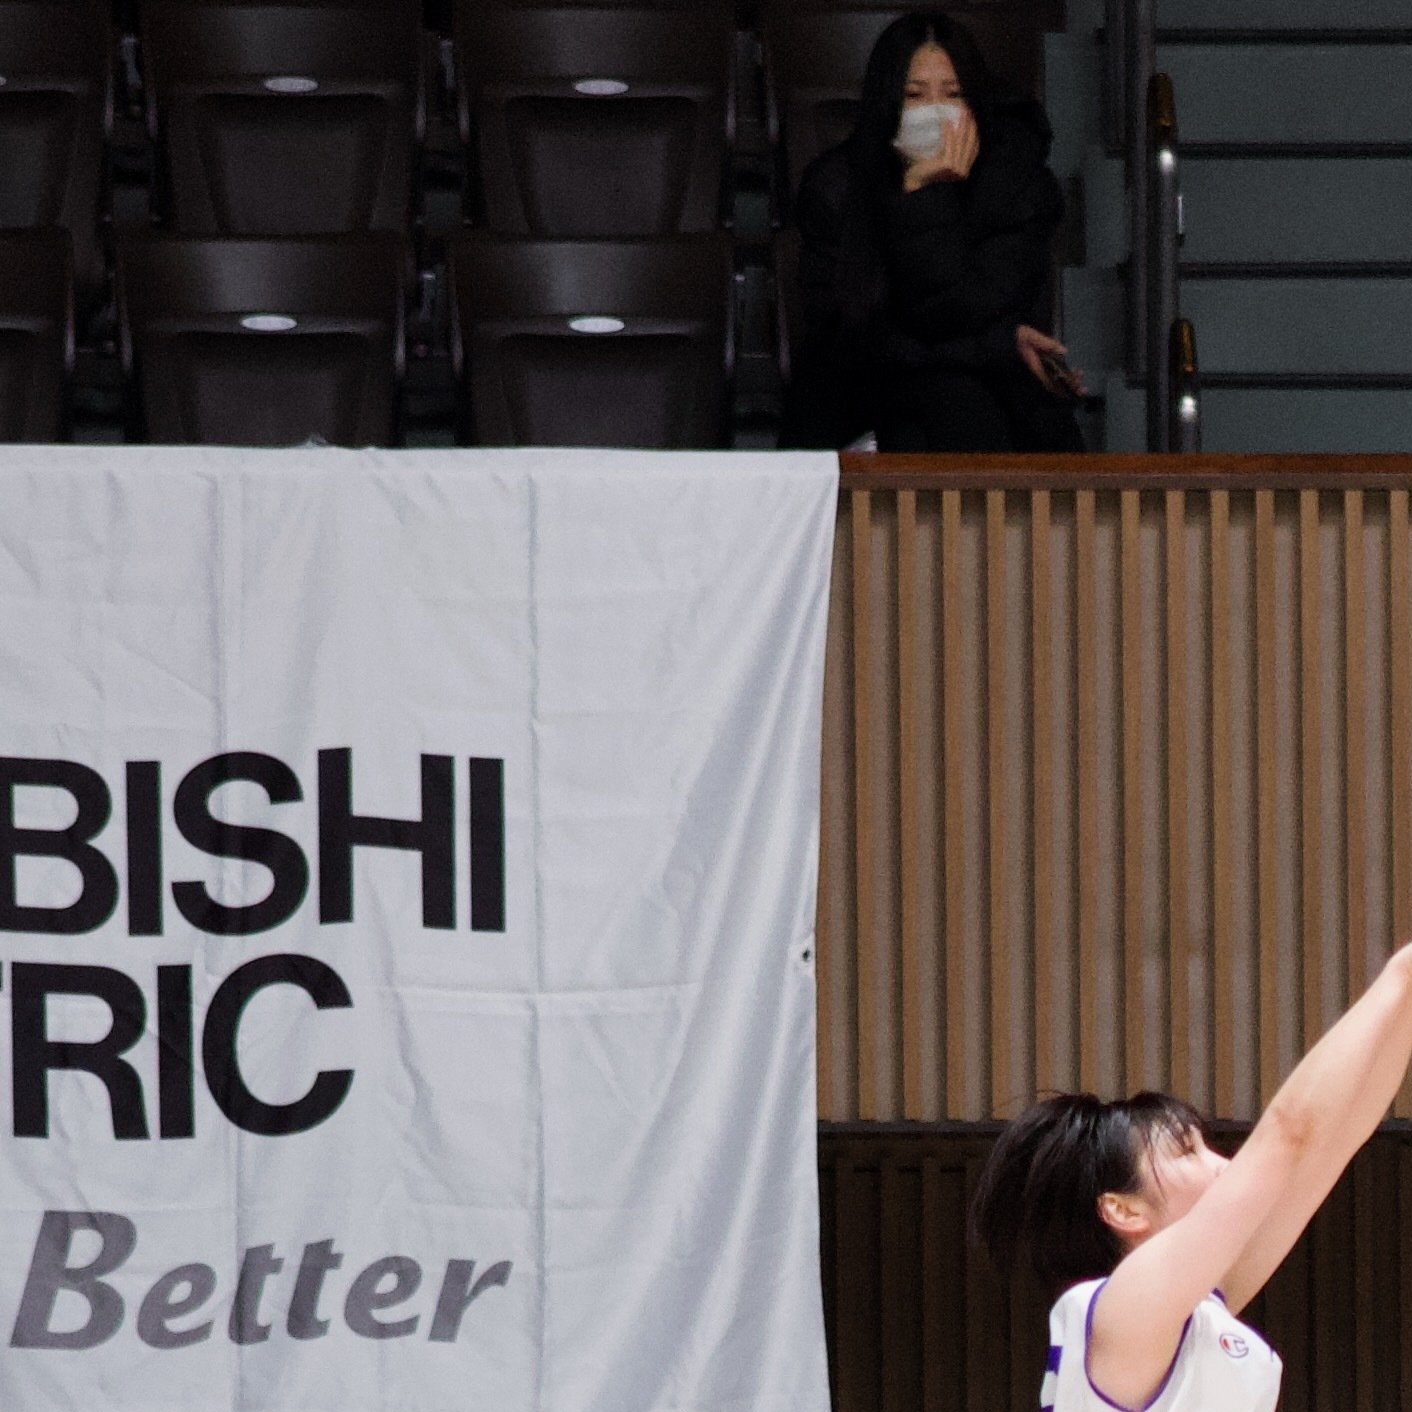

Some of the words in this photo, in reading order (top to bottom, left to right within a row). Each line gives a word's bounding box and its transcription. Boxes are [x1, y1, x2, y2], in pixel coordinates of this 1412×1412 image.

[0, 747, 507, 938] BISHI
[0, 954, 355, 1142] RIC
[9, 1209, 514, 1352] Better
